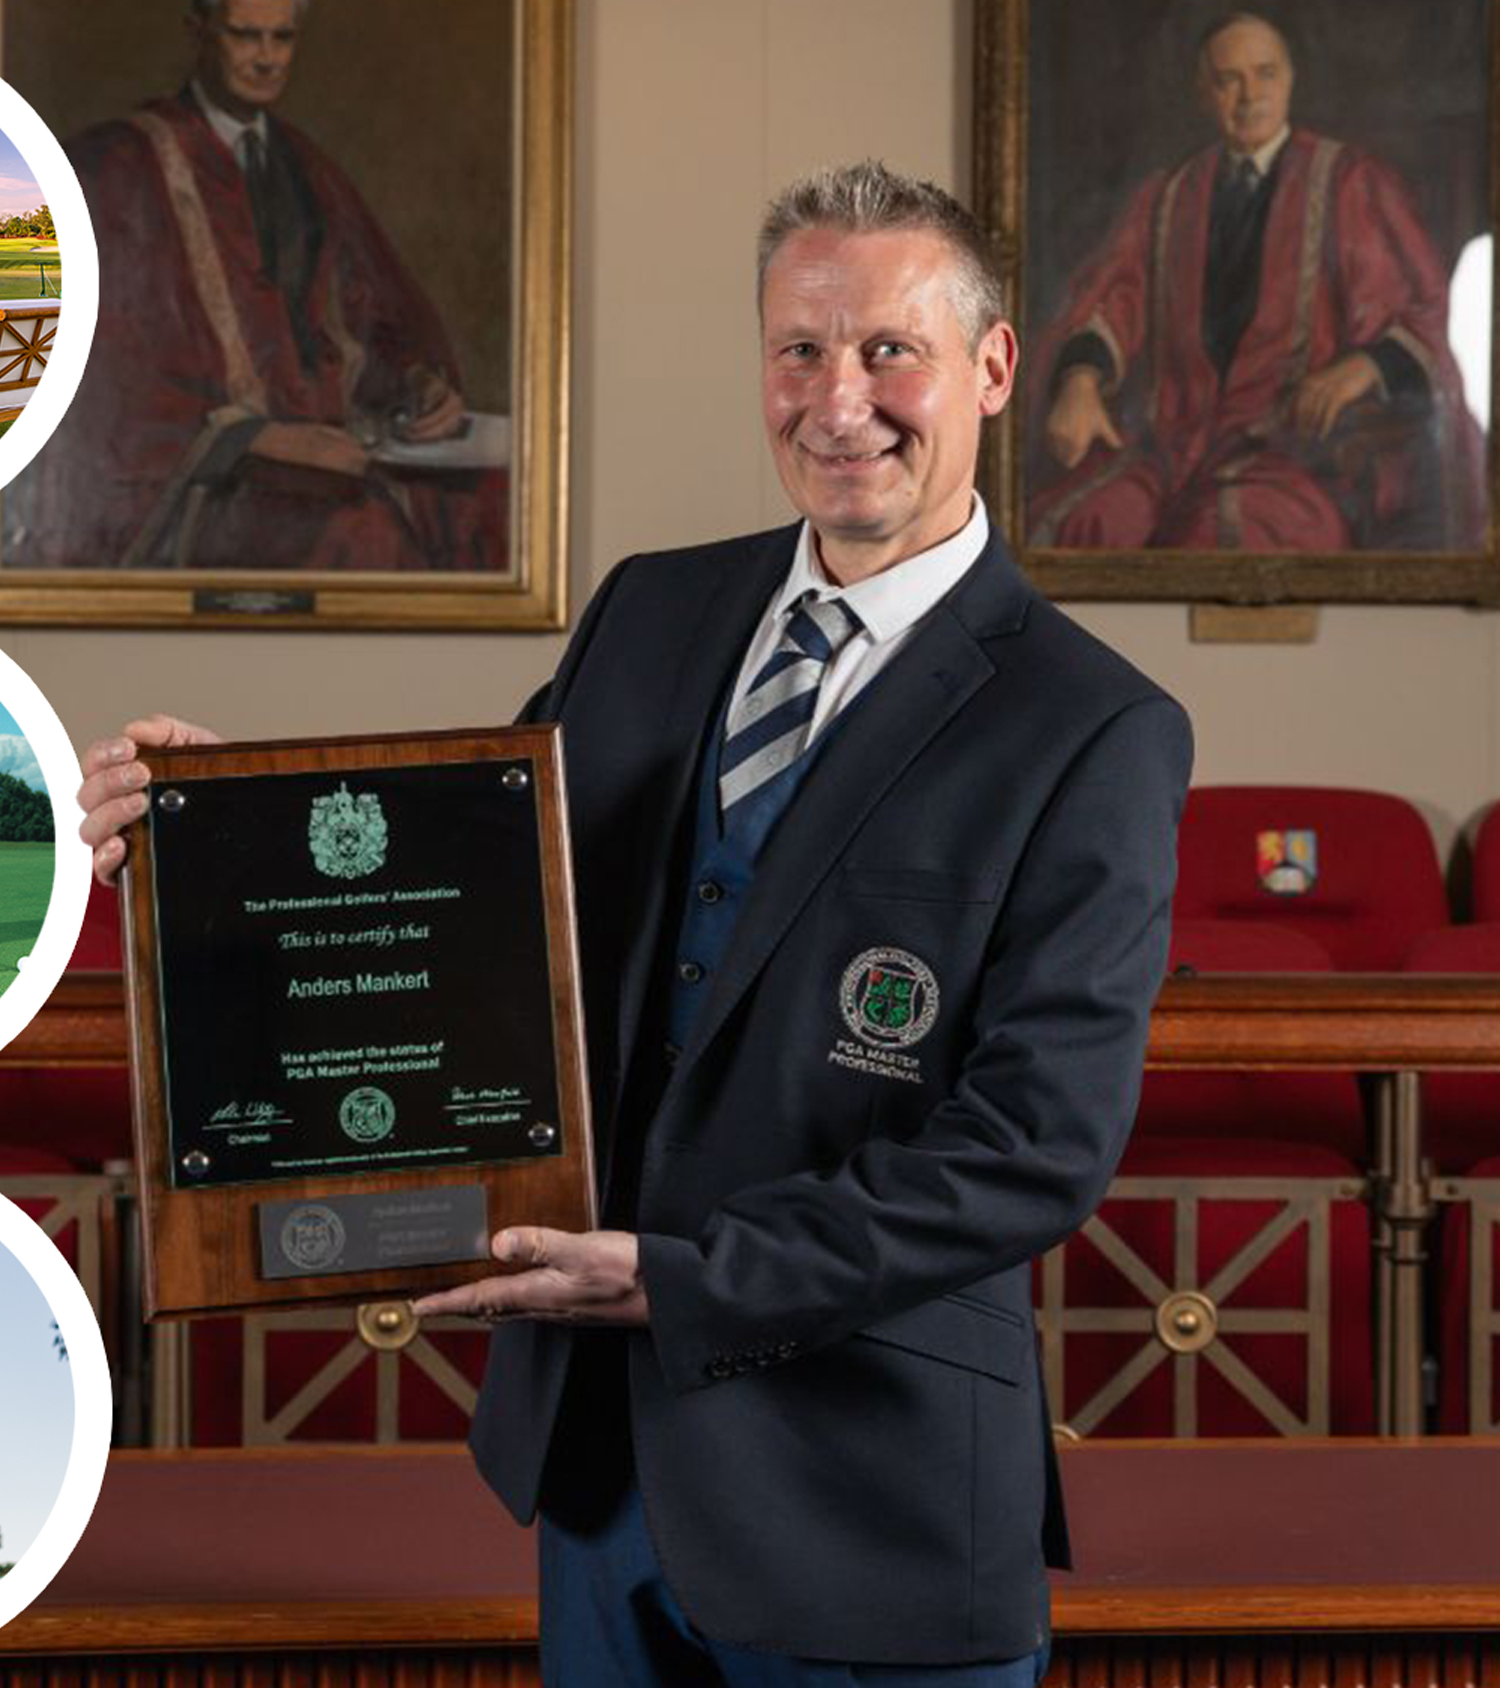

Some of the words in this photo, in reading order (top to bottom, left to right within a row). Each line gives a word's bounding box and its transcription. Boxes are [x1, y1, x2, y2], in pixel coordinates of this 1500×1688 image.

[245, 901, 267, 912] The
[269, 896, 342, 910] Professional
[393, 888, 461, 901] Association
[281, 932, 311, 949] This
[315, 931, 326, 946] is
[330, 931, 344, 945] to
[347, 924, 395, 946] certify
[400, 923, 430, 939] that
[287, 977, 351, 999] Anders
[356, 970, 430, 992] Mankert
[366, 1046, 386, 1058] the
[836, 1040, 864, 1056] PGA
[287, 1067, 314, 1079] PGA
[317, 1064, 360, 1077] Master
[363, 1057, 440, 1073] Professional
